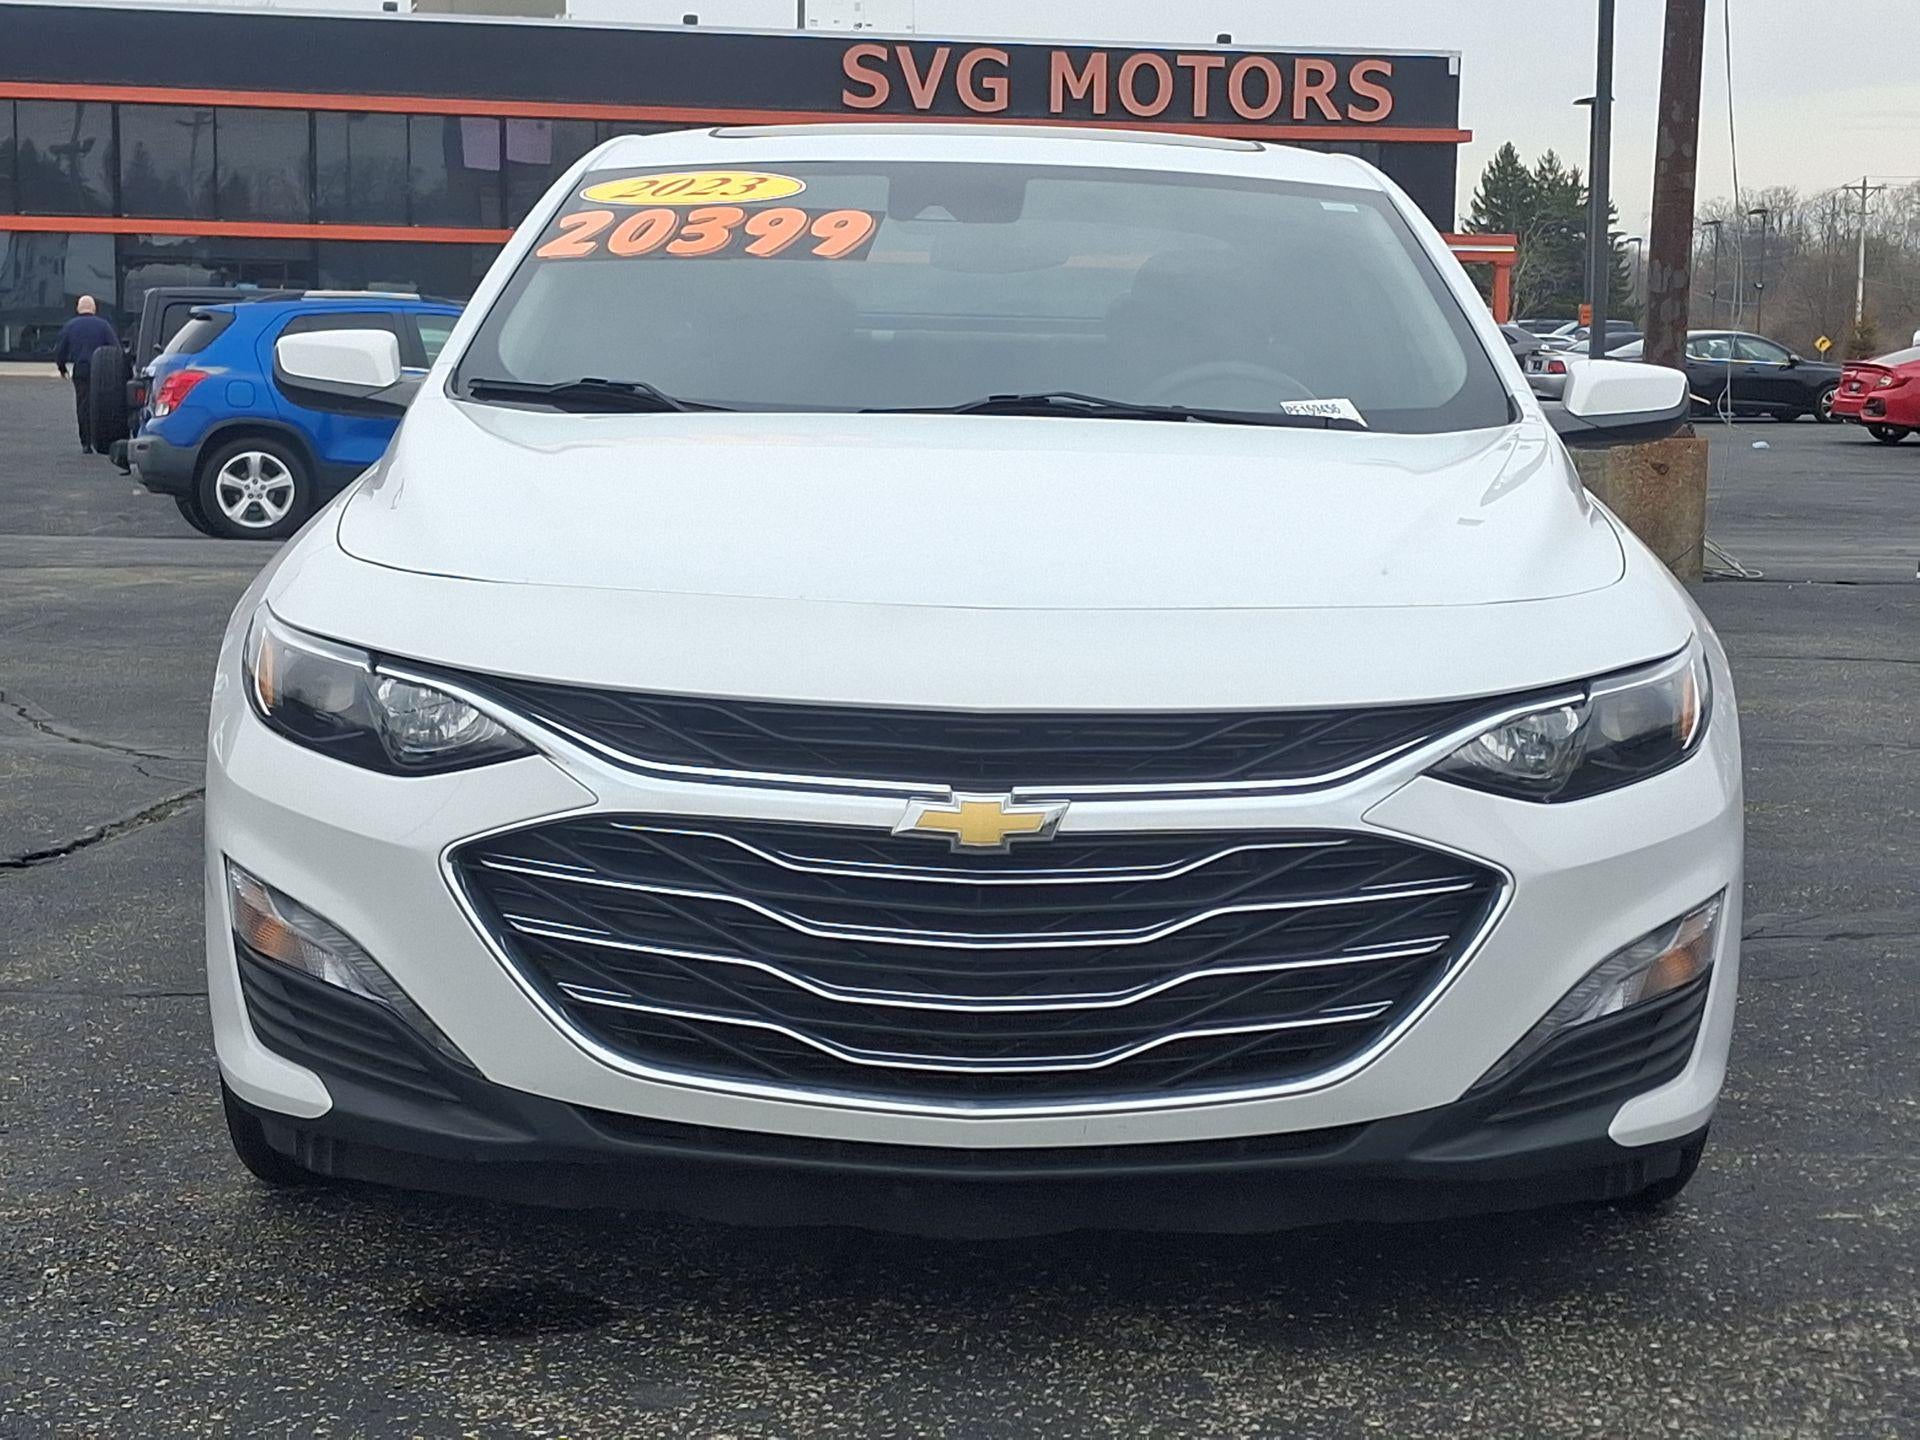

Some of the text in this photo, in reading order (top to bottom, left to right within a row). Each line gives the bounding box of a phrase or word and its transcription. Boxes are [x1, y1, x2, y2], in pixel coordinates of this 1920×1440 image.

[842, 43, 1394, 123] SVG MOTORS
[613, 176, 769, 199] 2023
[535, 206, 877, 260] 20399
